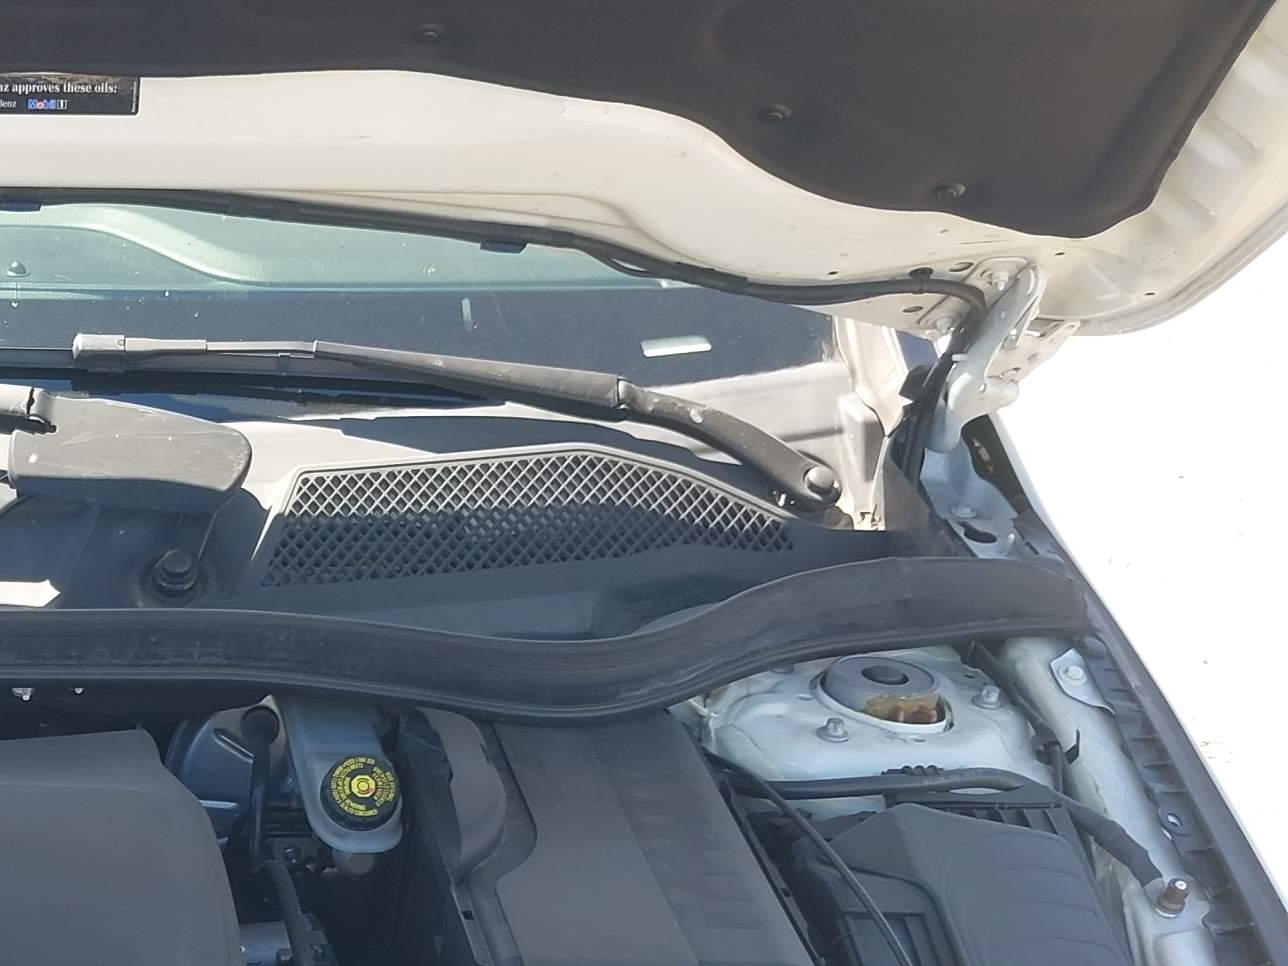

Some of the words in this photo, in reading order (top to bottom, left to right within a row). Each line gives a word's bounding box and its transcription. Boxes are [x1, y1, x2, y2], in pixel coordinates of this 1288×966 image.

[12, 83, 60, 95] approves
[63, 82, 92, 93] these
[94, 82, 118, 93] oils:
